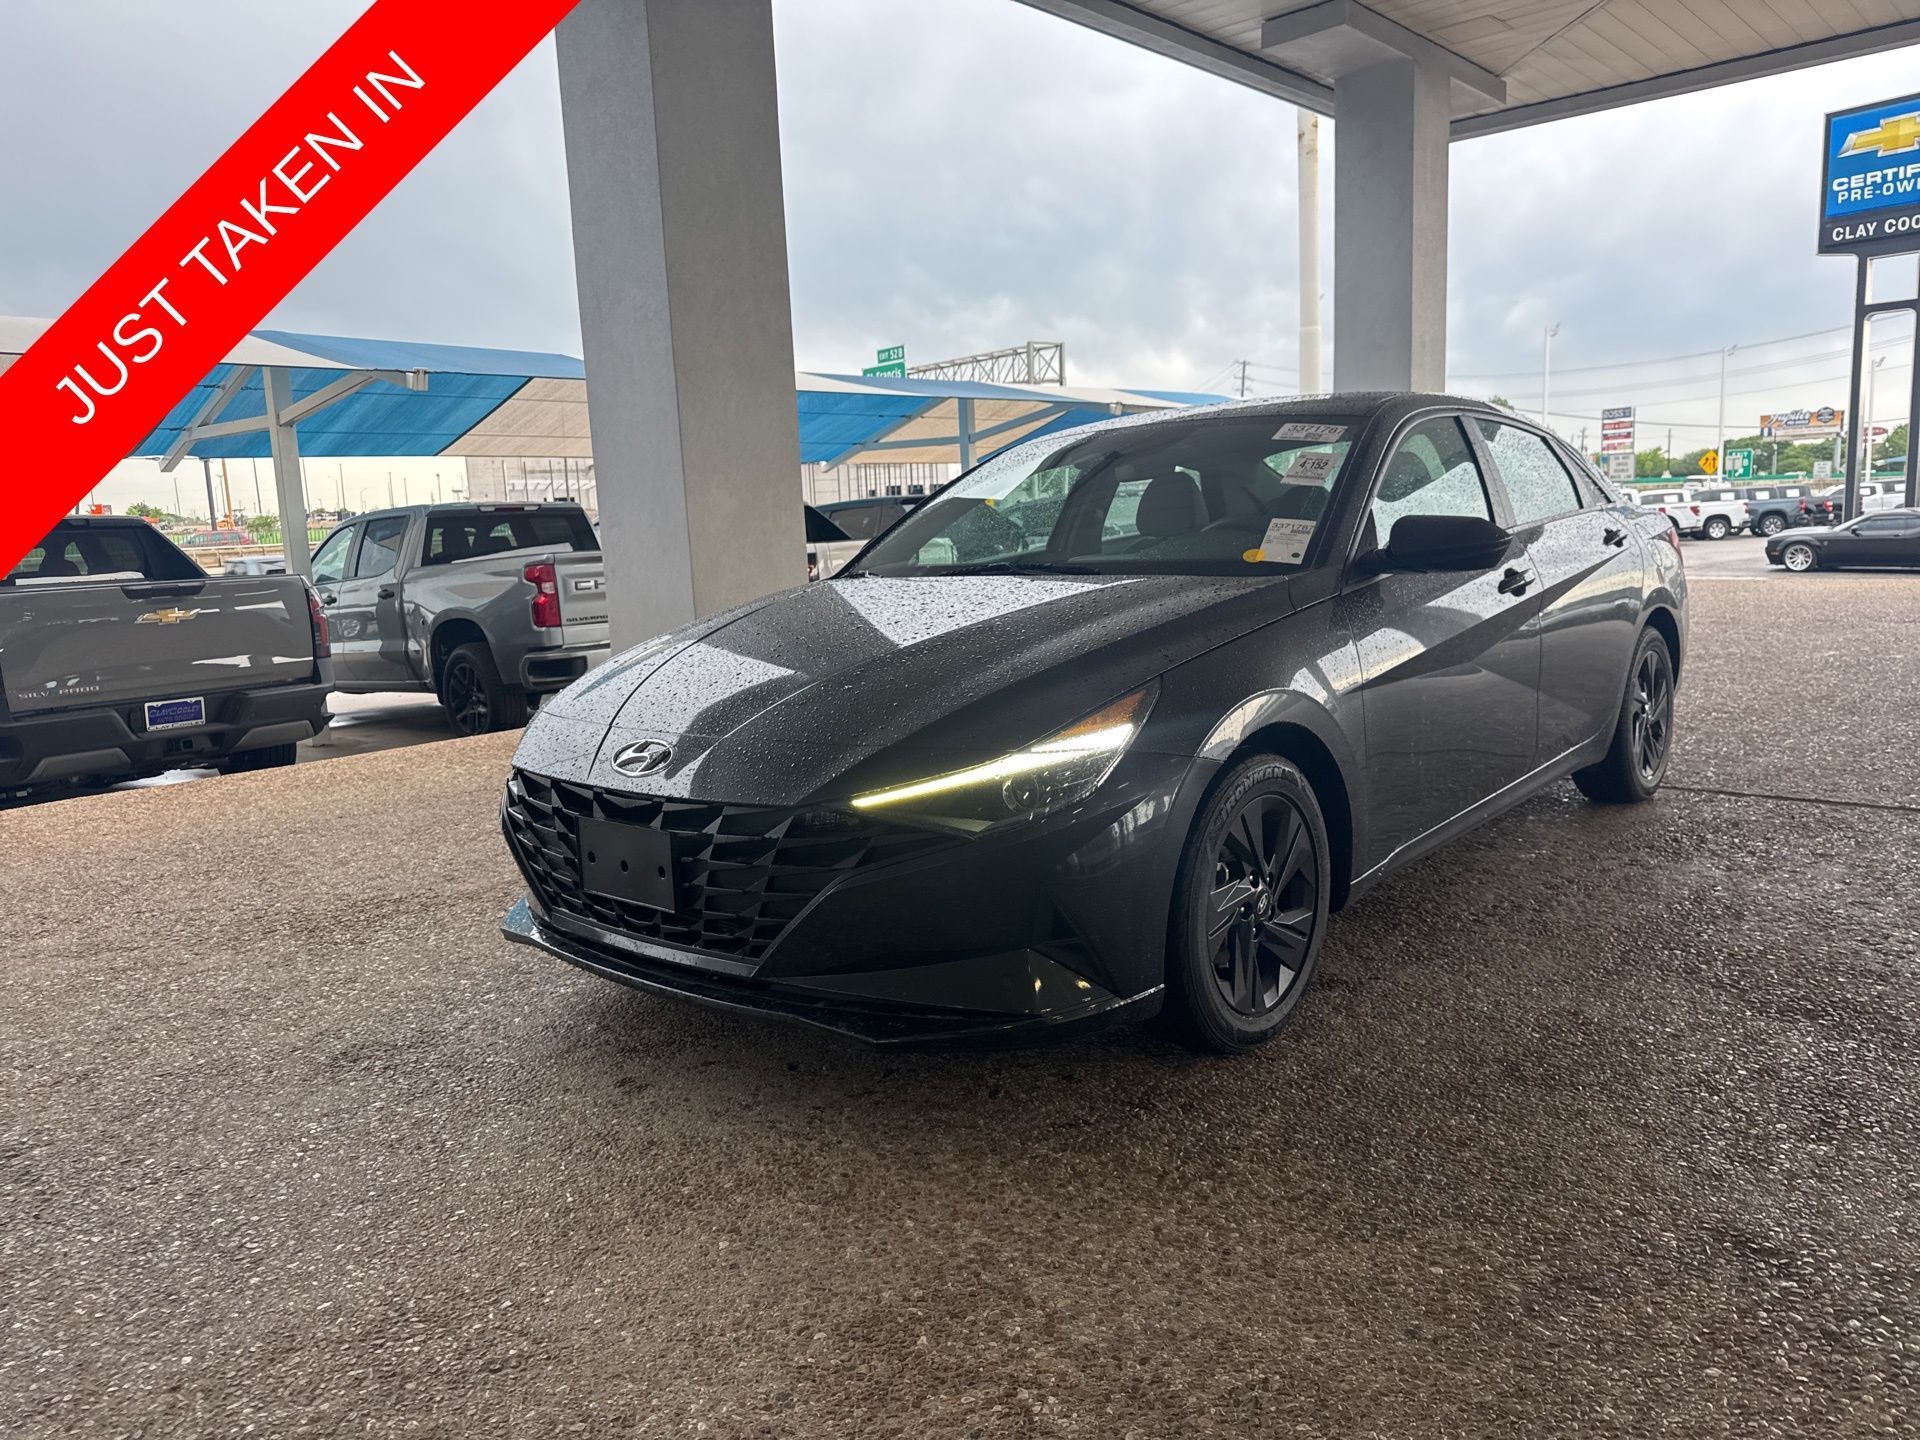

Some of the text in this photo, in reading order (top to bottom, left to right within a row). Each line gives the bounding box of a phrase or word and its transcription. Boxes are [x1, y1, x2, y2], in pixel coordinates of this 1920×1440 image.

[1837, 177, 1920, 204] PRE-OW
[1832, 222, 1877, 242] CLAY
[18, 685, 100, 699] SILVRADO
